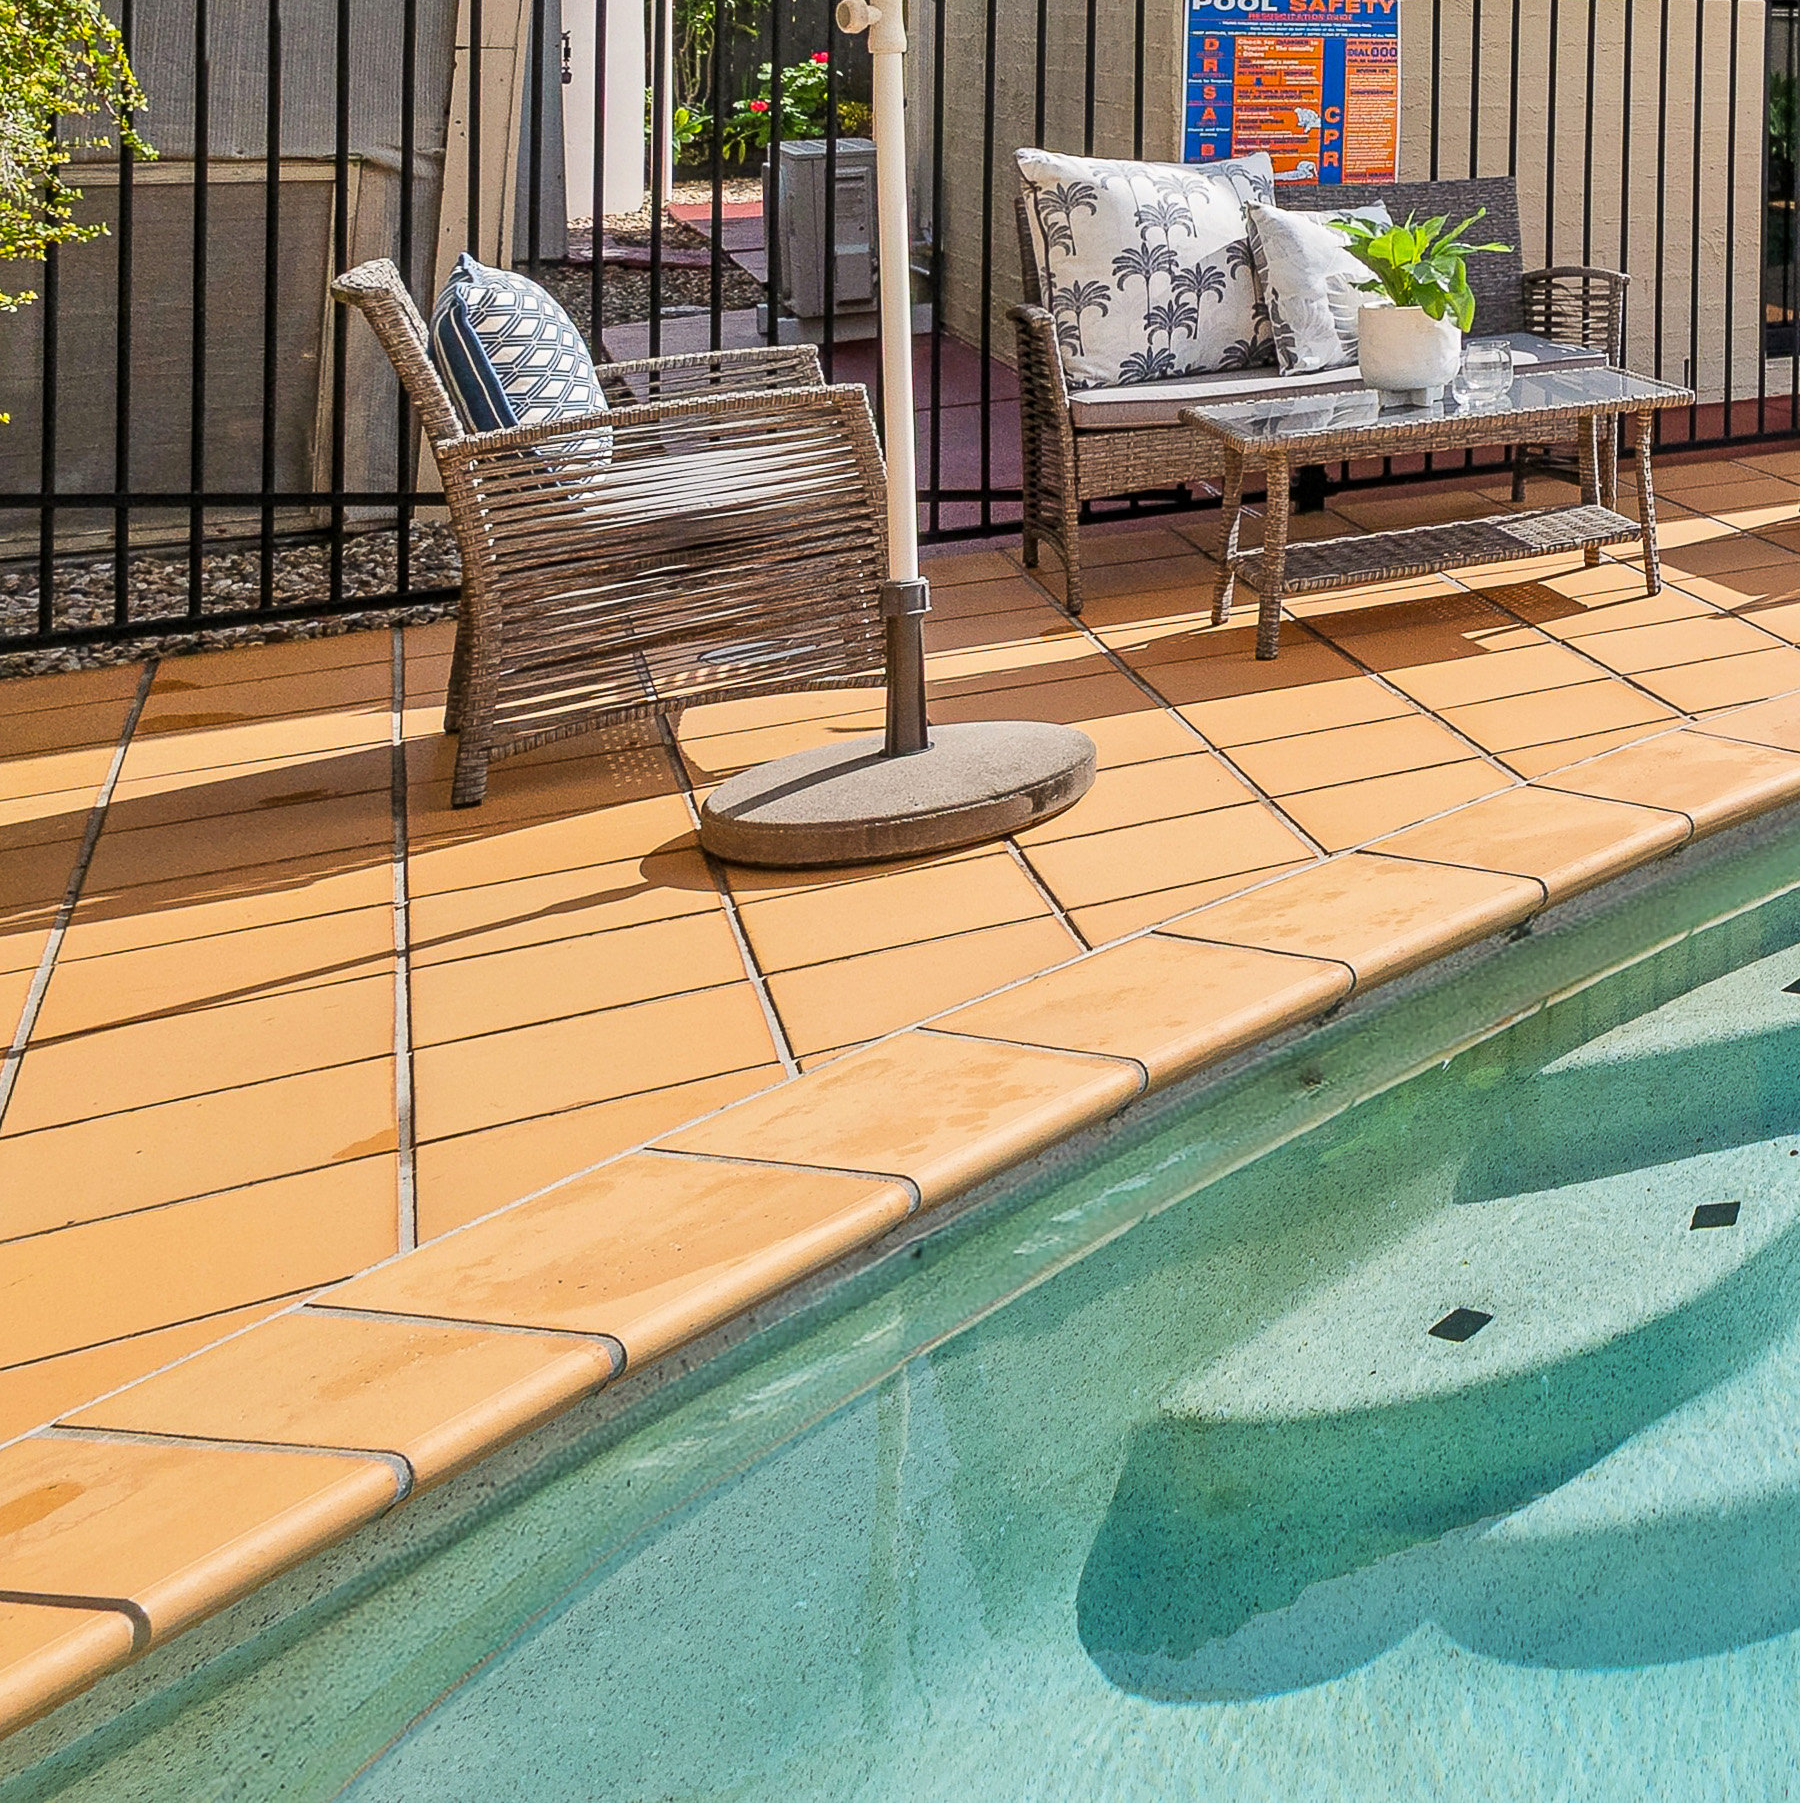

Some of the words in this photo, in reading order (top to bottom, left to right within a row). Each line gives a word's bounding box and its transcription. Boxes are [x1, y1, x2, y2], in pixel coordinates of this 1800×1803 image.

[1204, 38, 1219, 51] D
[1347, 48, 1370, 57] DIAL
[1371, 47, 1397, 57] 000
[1203, 58, 1218, 72] R
[1203, 86, 1217, 100] S
[1202, 106, 1217, 120] A
